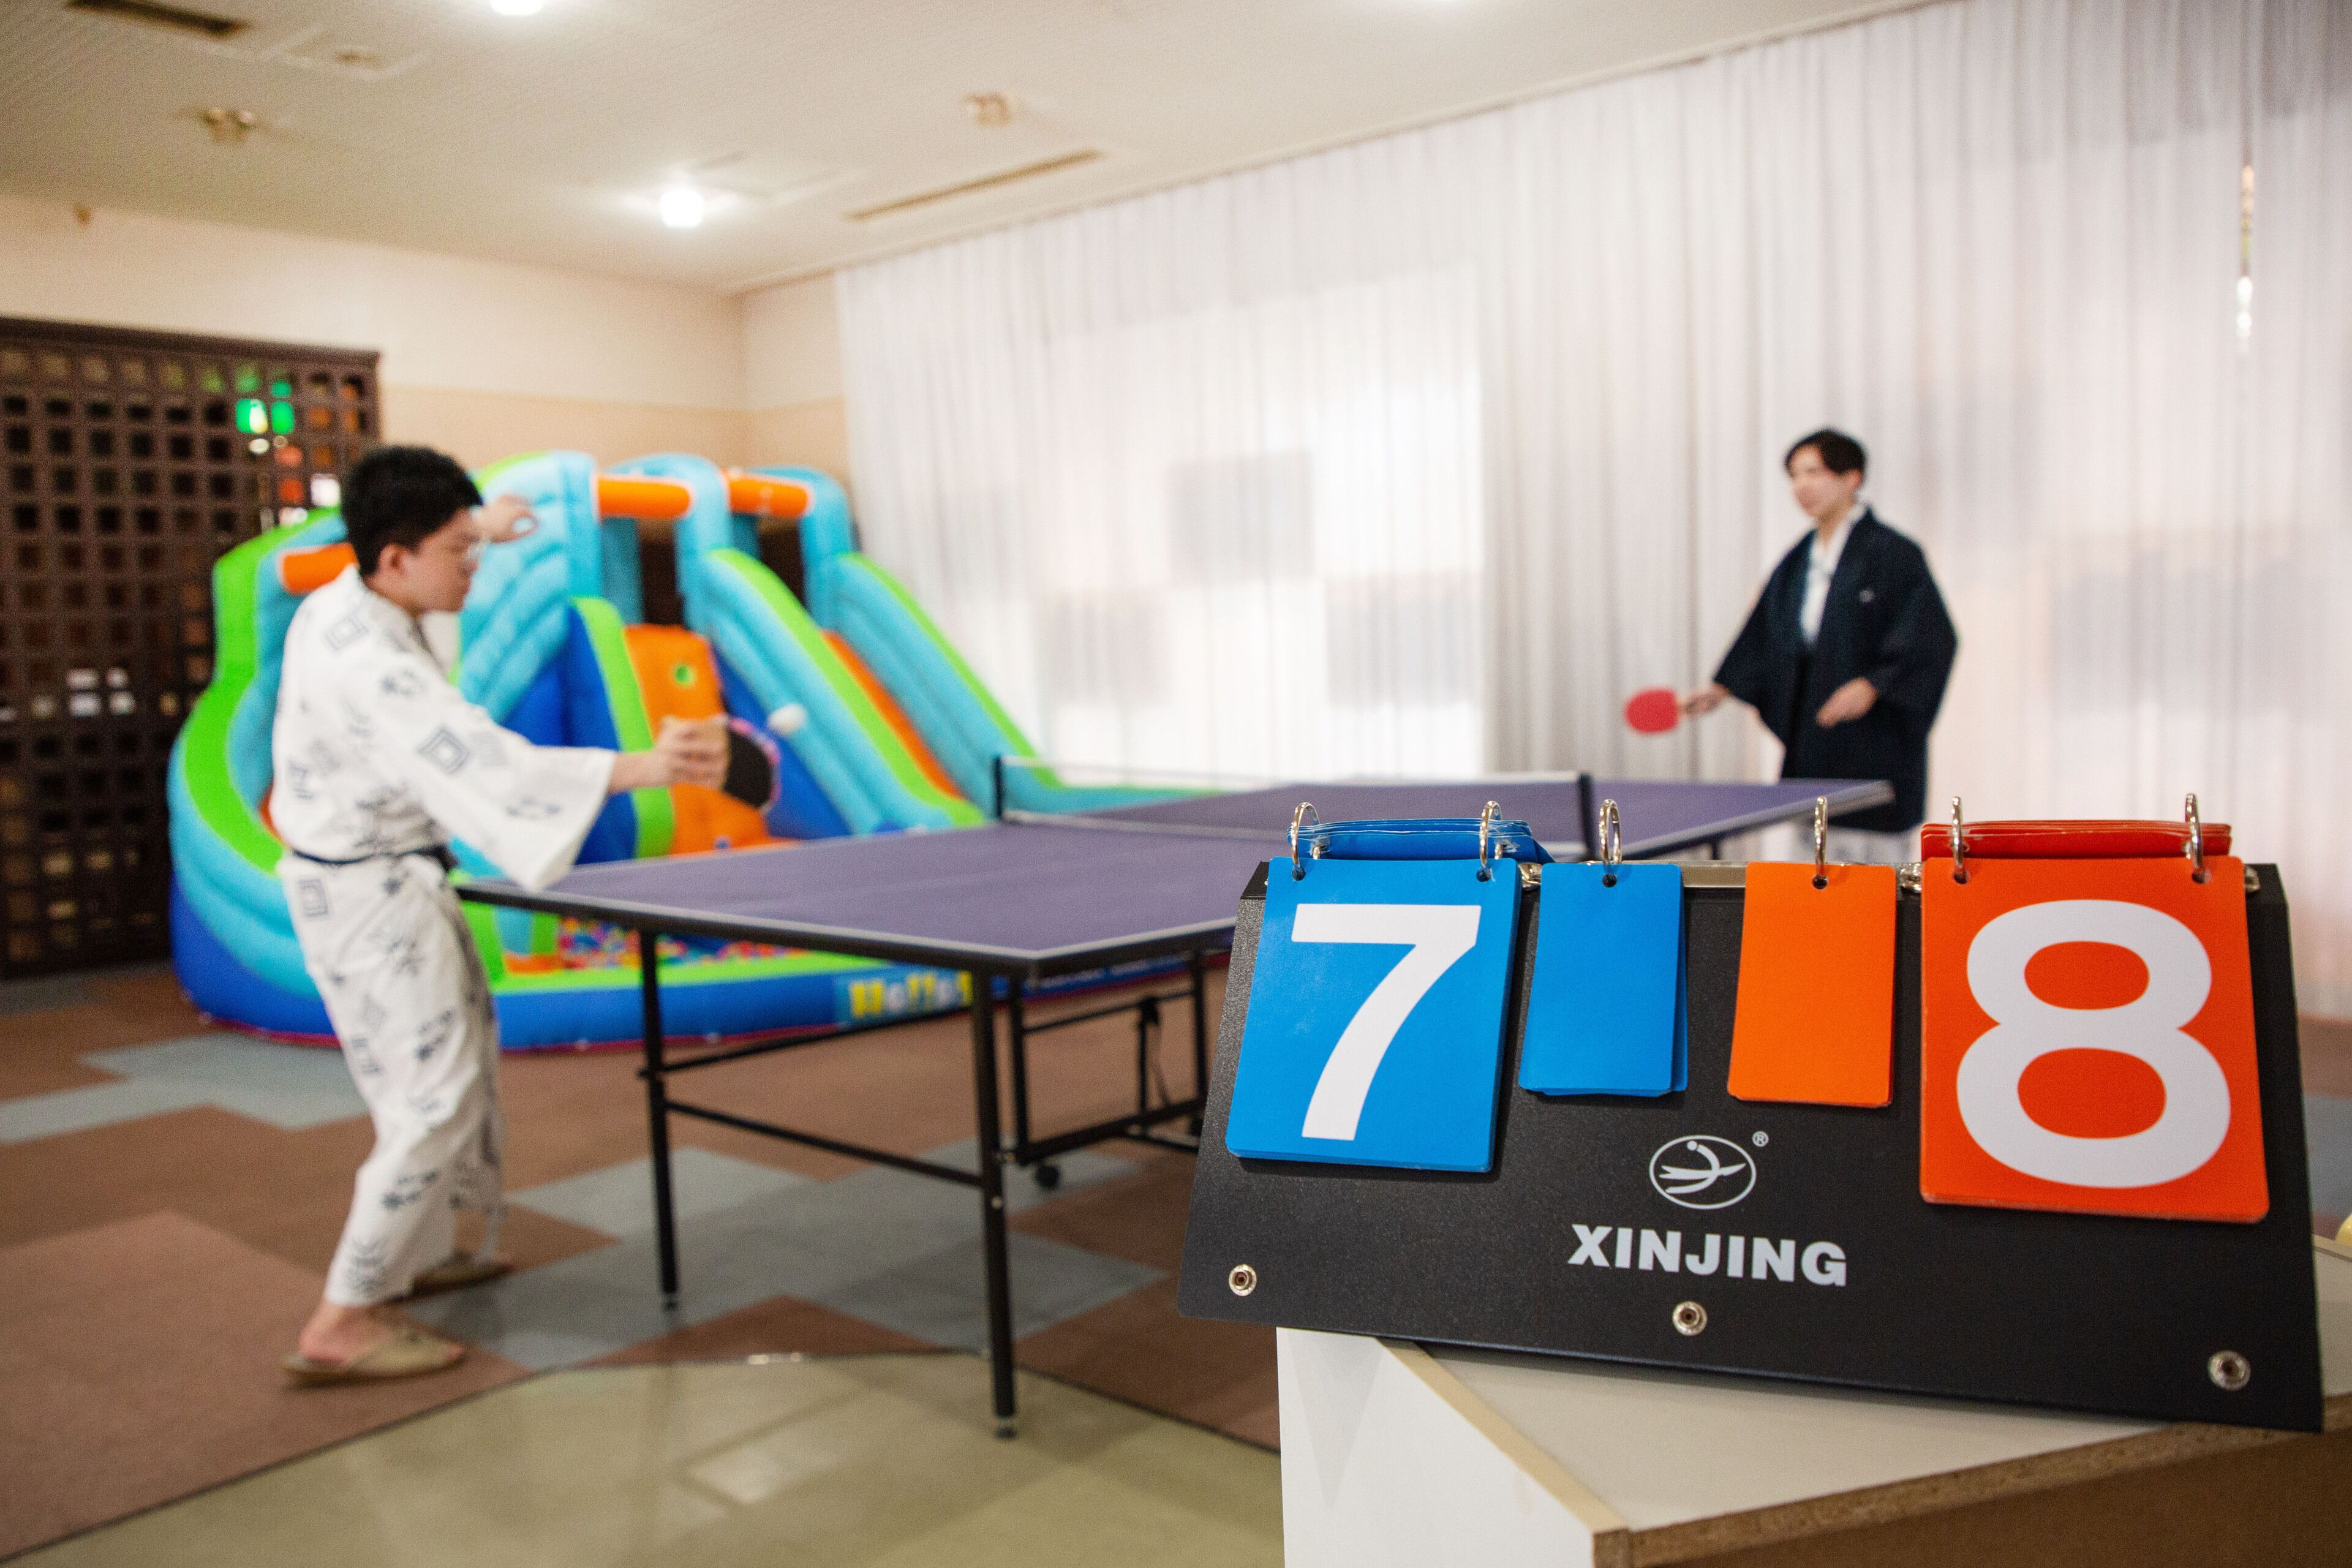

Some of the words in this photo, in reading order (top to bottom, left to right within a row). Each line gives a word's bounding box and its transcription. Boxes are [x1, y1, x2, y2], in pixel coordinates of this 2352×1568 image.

[1292, 904, 1481, 1140] 7
[1958, 900, 2230, 1187] 8
[1568, 1224, 1846, 1287] XINJING
